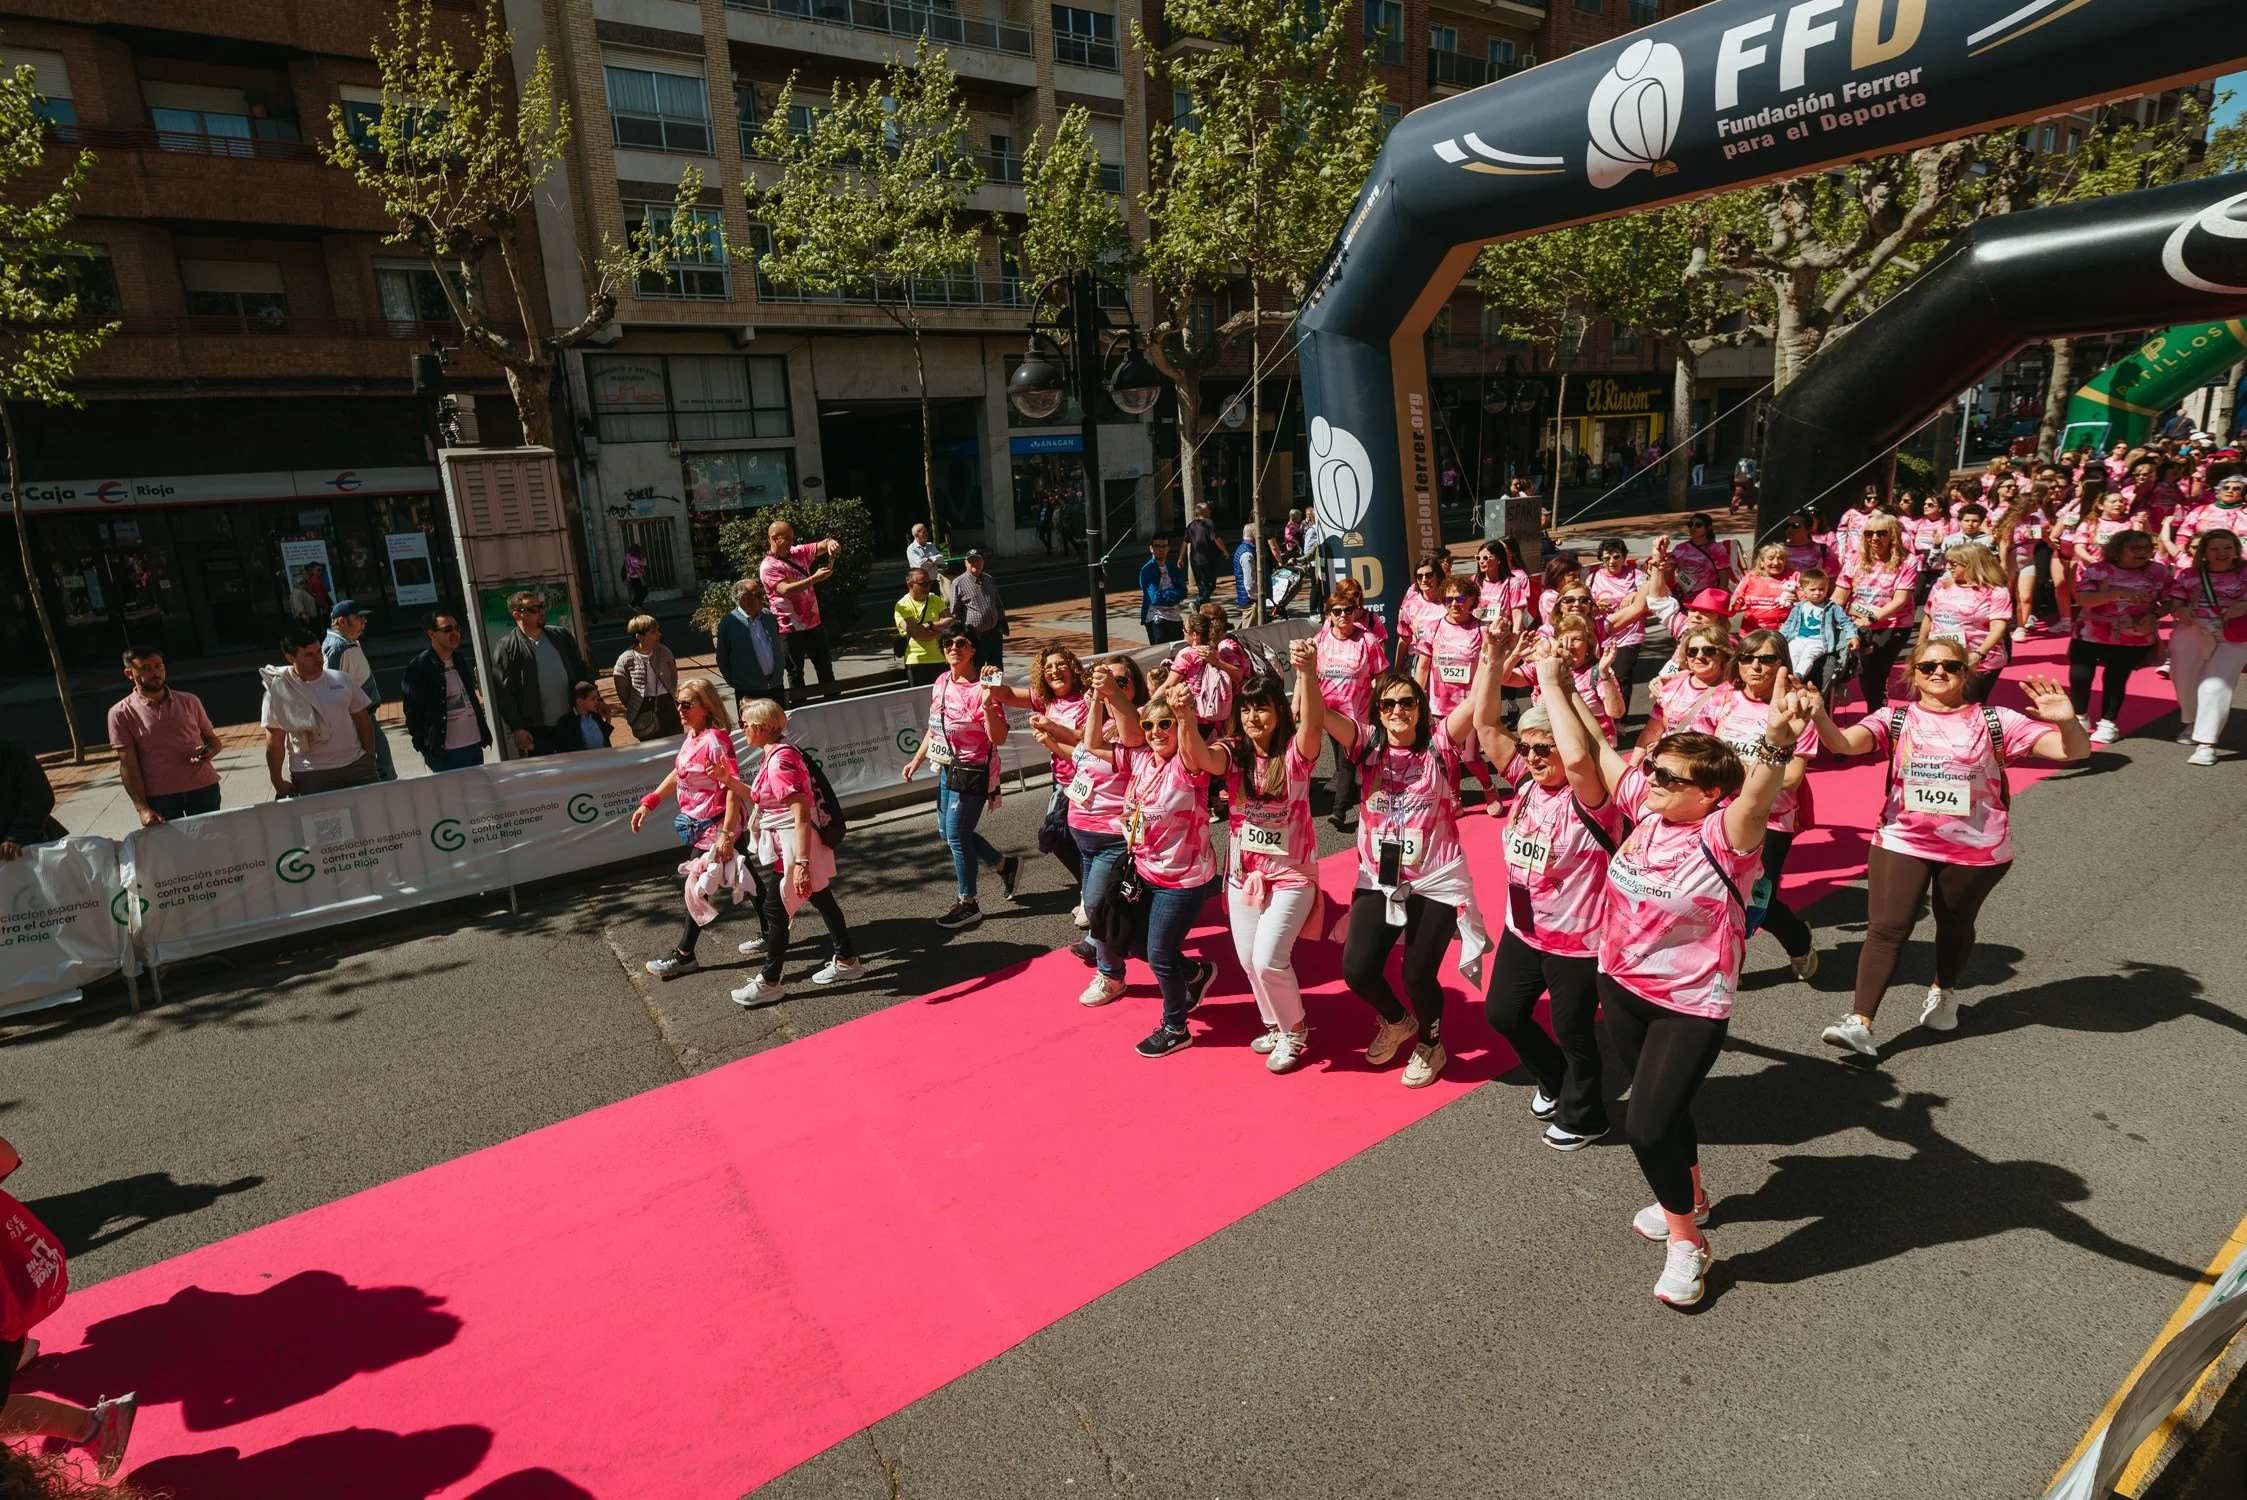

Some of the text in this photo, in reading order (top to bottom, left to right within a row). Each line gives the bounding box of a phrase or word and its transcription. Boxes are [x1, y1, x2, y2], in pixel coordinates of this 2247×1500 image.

[1715, 0, 1927, 112] FFD
[1716, 66, 1923, 138] Fundación Ferrer
[1722, 91, 1927, 160] para el Deporte
[2115, 326, 2223, 395] PITILLOS
[1586, 379, 1650, 412] El Rincón
[137, 484, 175, 498] Rioja
[1443, 667, 1465, 677] 9521
[825, 734, 891, 753] asociación española
[827, 745, 880, 760] contra el cáncer
[828, 755, 865, 769] en La Rioja
[1911, 762, 1928, 770] por
[602, 784, 645, 799] asociación
[603, 794, 640, 808] contra el
[1915, 789, 1958, 805] 1494
[470, 801, 560, 825] asociación española
[604, 808, 616, 817] en
[616, 805, 628, 815] La
[471, 813, 544, 835] contra el cáncer
[321, 827, 422, 854] asociación española
[472, 827, 523, 845] en La Rioja
[1248, 828, 1282, 845] 5082
[322, 841, 404, 865] contra el cáncer
[1513, 839, 1546, 861] 5087
[154, 859, 266, 889] asociación española
[323, 855, 379, 875] en La Rioja
[156, 872, 245, 899] contra el cáncer
[170, 895, 187, 907] La
[188, 889, 217, 904] Rioja
[0, 913, 78, 936] tra el cáncer
[17, 931, 51, 945] Rioja
